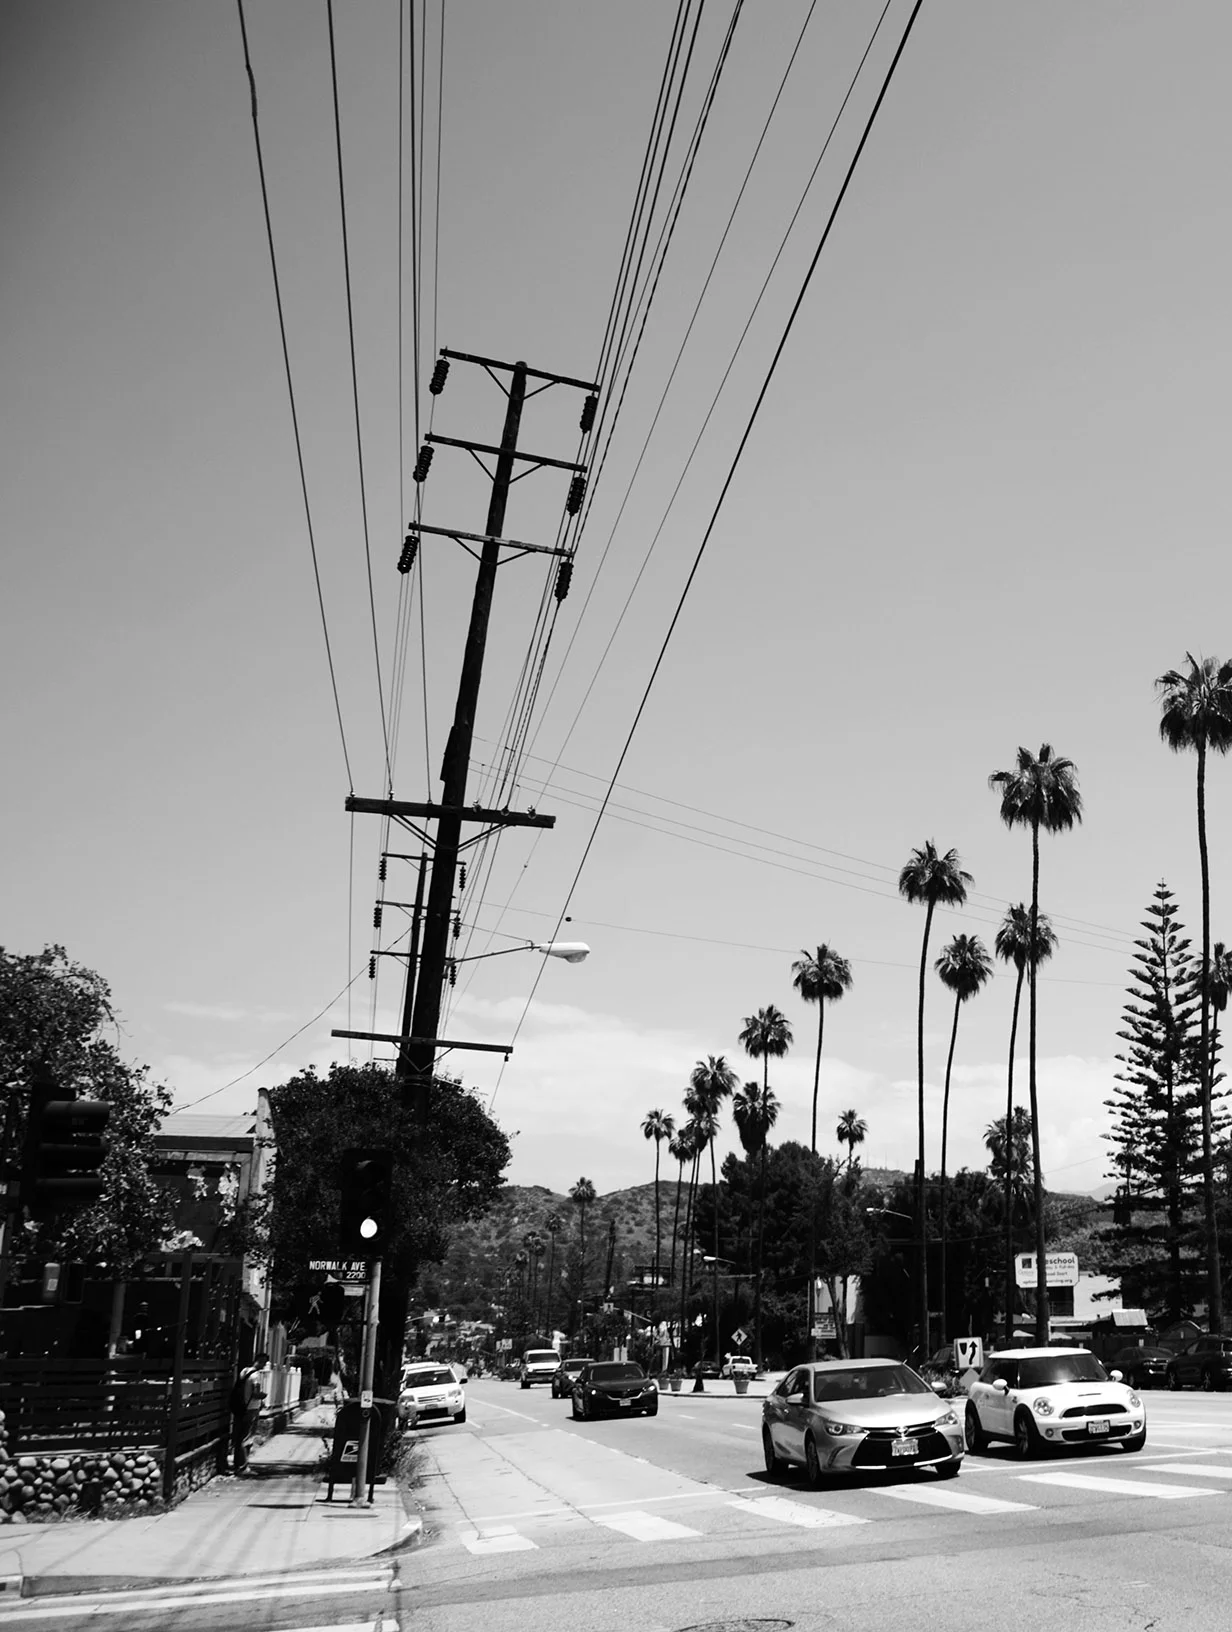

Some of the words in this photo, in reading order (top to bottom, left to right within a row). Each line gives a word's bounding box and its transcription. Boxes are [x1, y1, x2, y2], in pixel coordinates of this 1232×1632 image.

[309, 1261, 348, 1271] NORWALK
[350, 1261, 366, 1271] AVE
[346, 1271, 366, 1279] 2200
